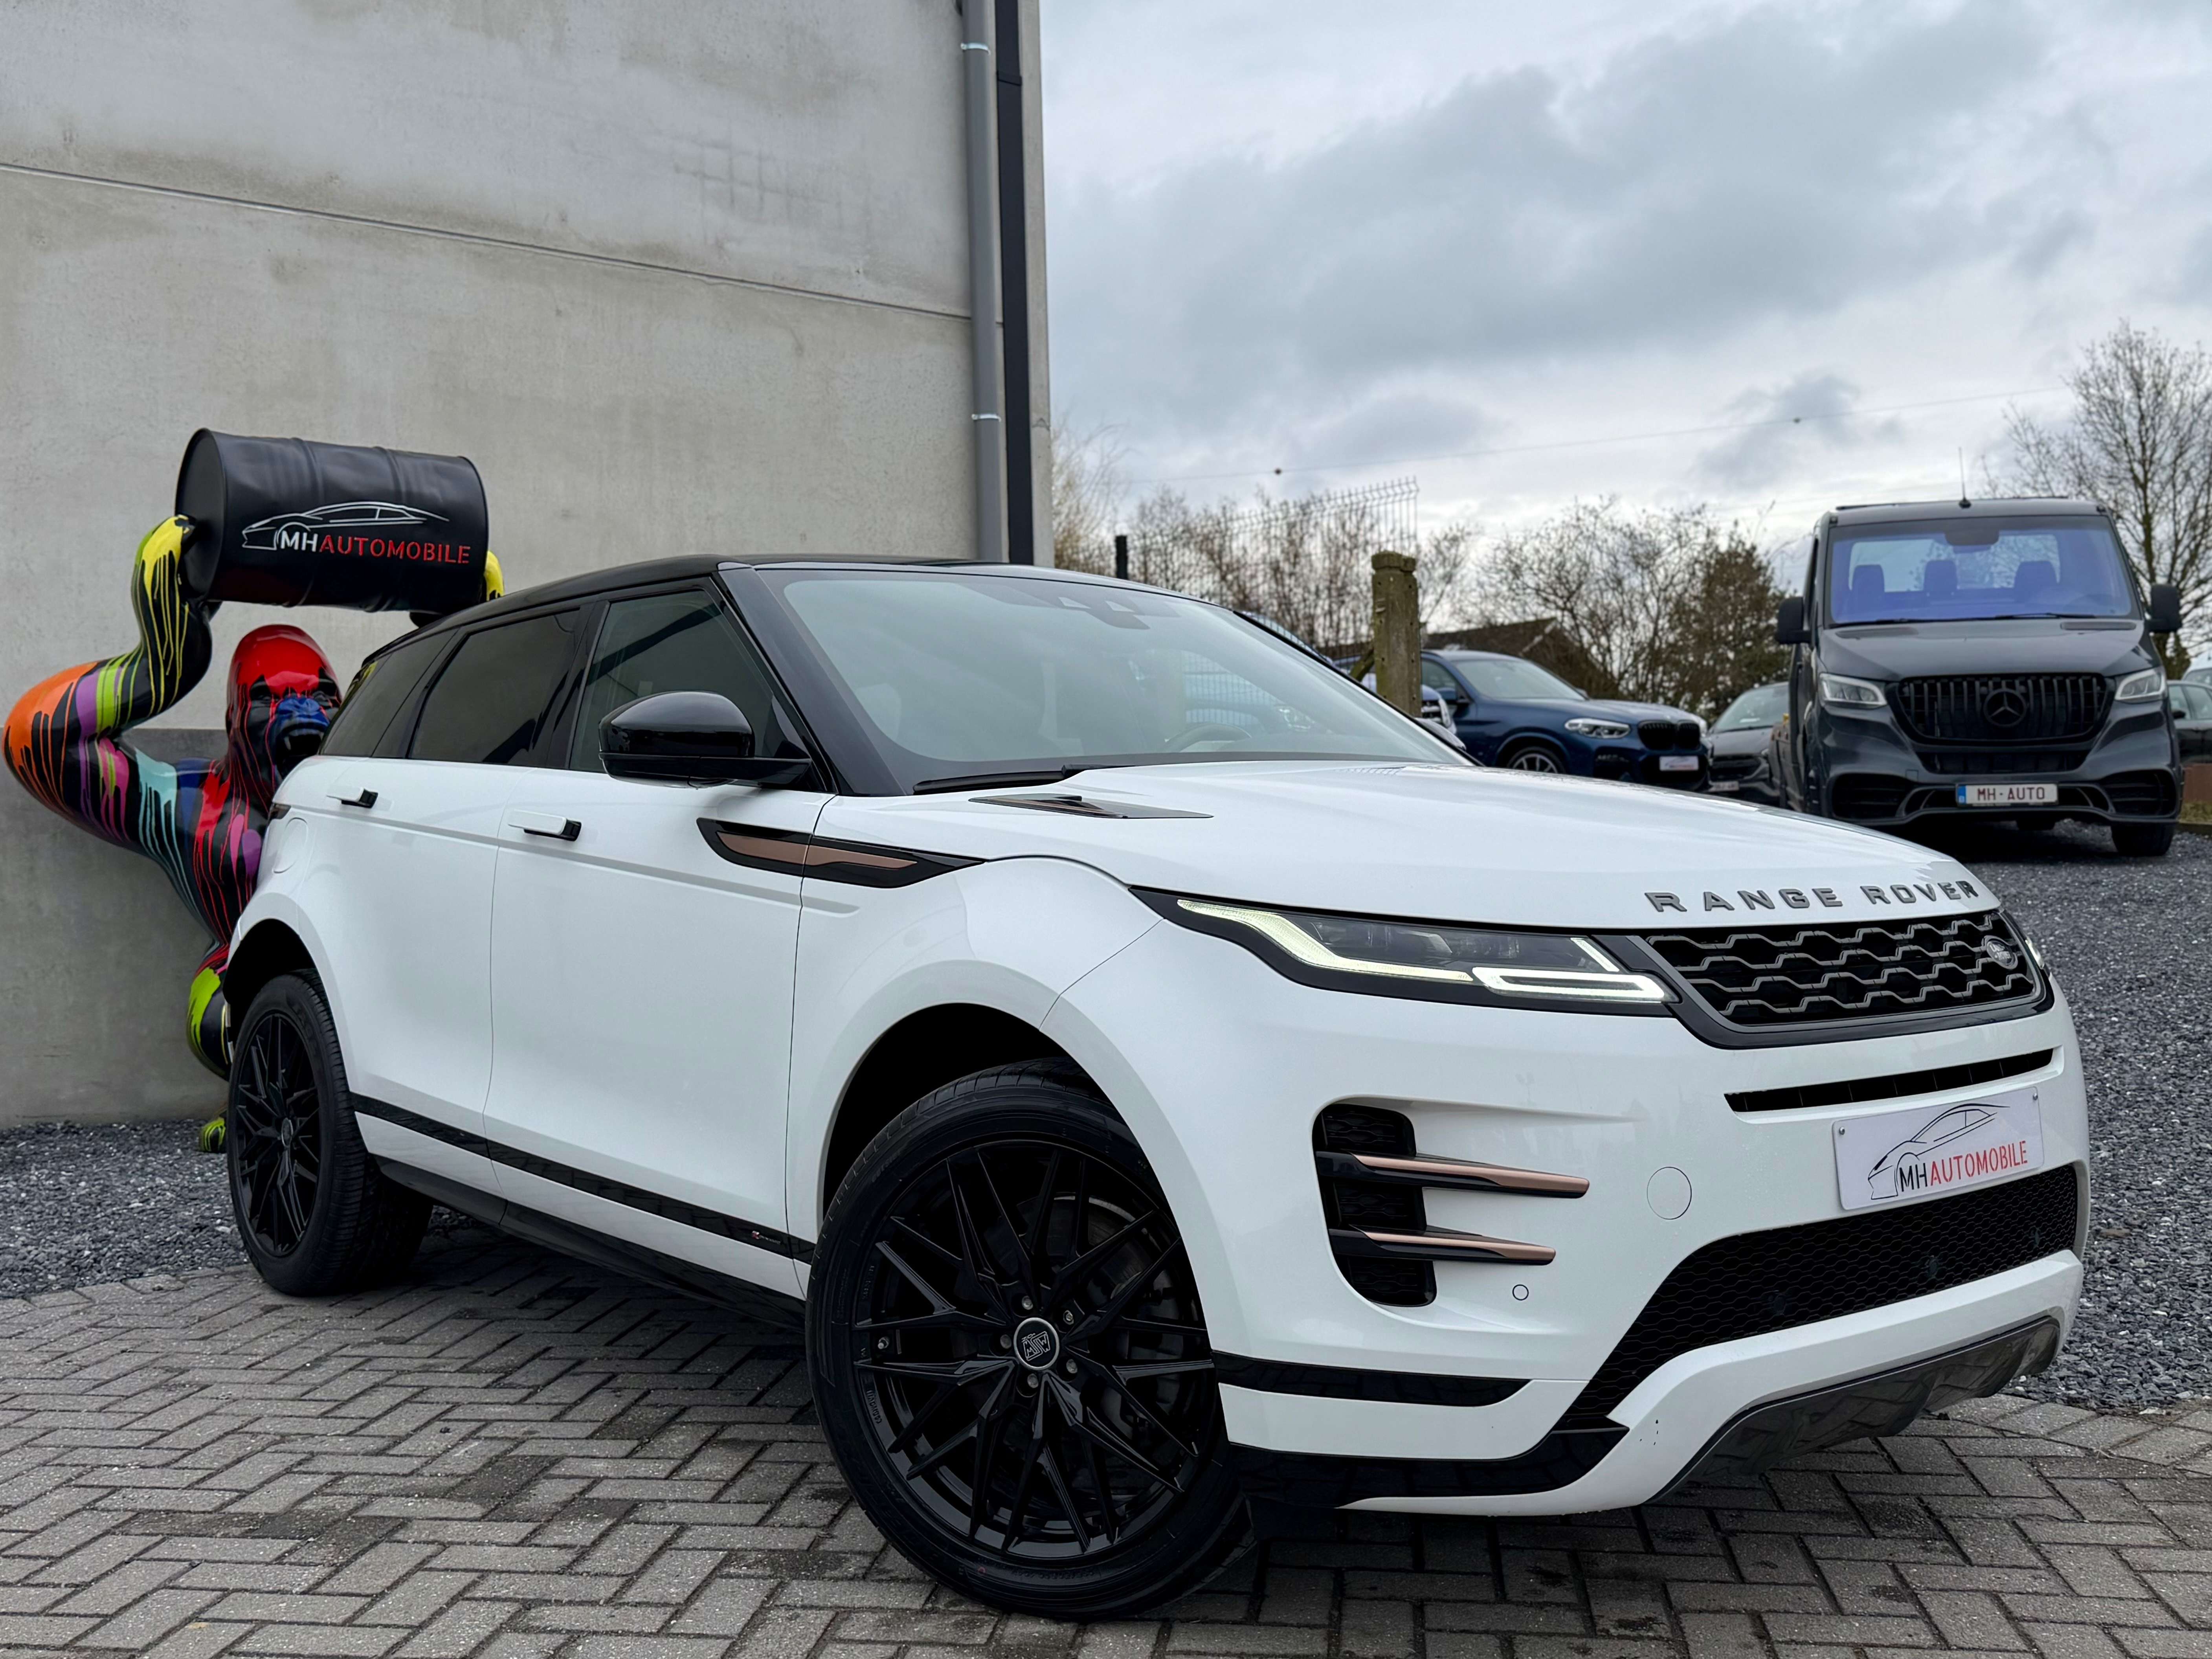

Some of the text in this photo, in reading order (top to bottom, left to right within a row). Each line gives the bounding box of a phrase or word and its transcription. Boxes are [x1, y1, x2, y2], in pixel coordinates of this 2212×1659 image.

[281, 529, 471, 564] MHAUTOMOBILE
[1645, 880, 1979, 912] RANGE ROVER
[1899, 1141, 2028, 1192] MHAUTOMOBILE
